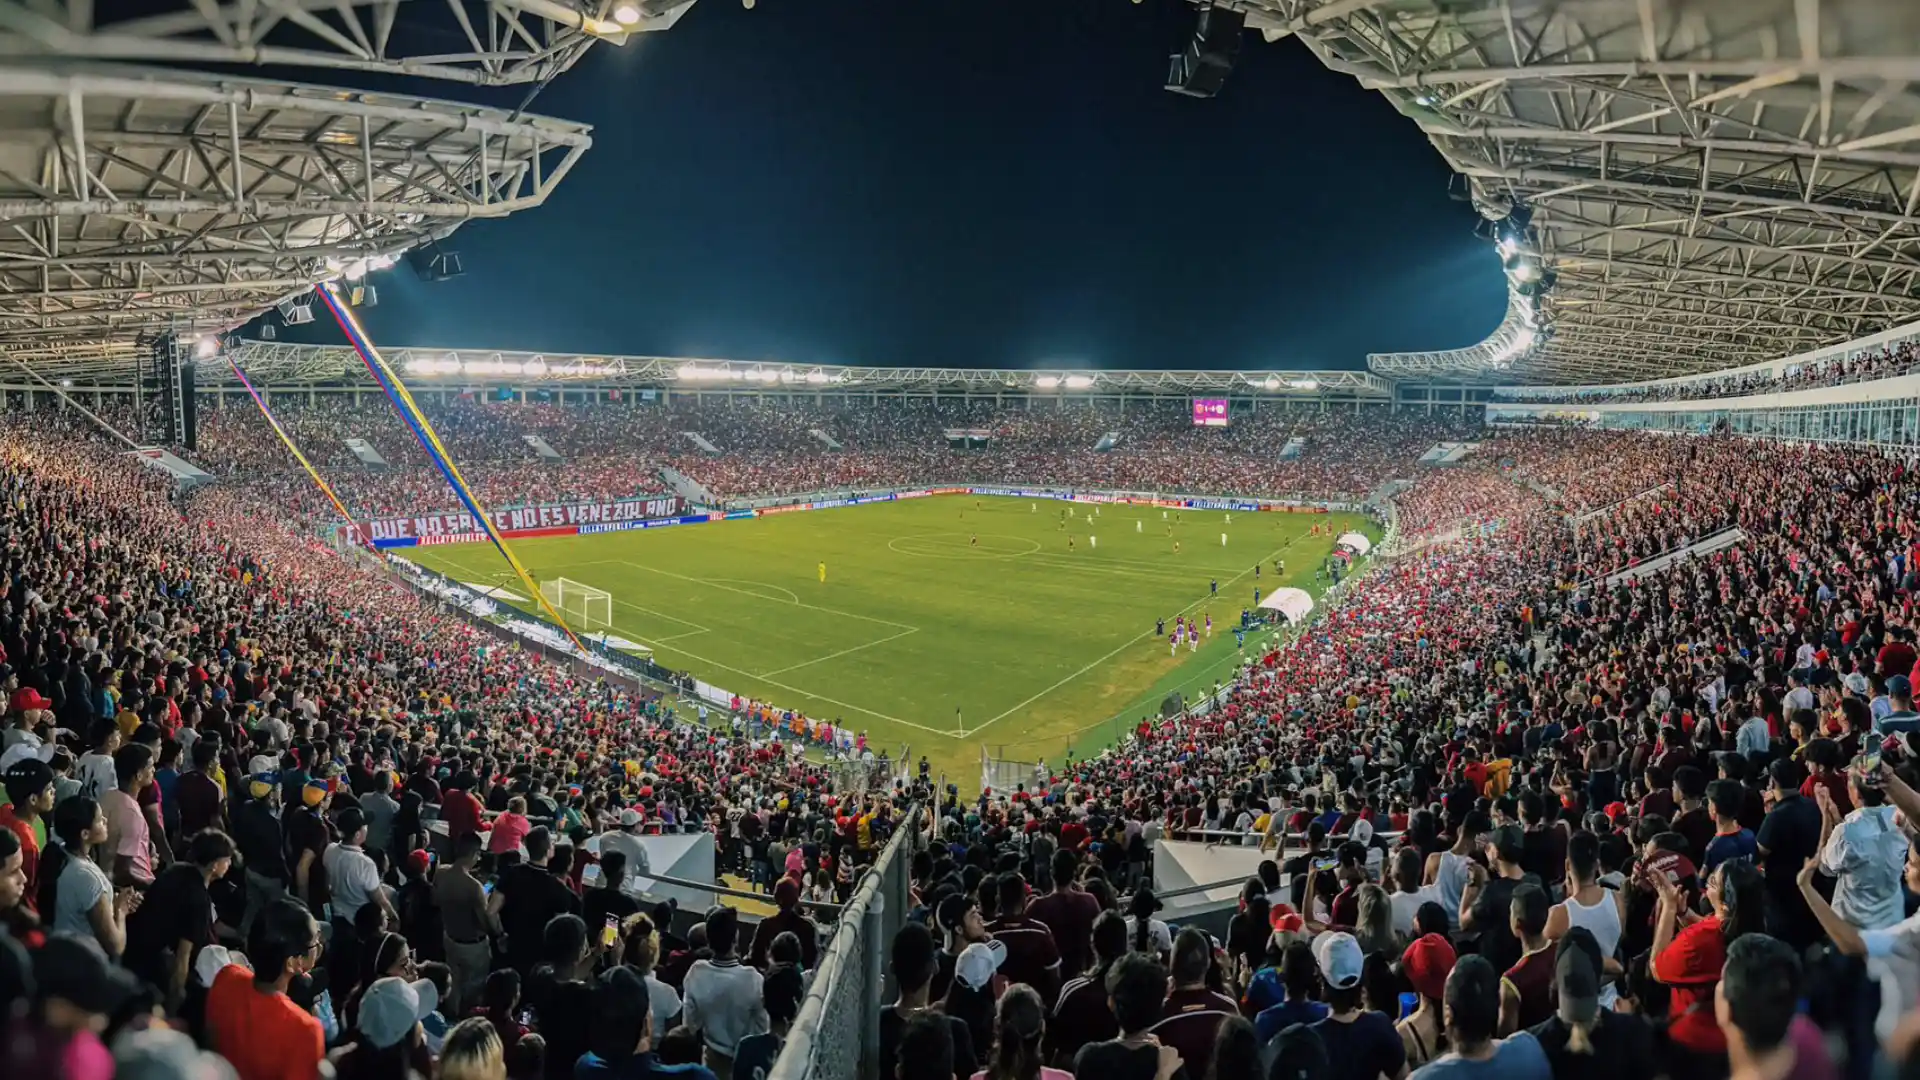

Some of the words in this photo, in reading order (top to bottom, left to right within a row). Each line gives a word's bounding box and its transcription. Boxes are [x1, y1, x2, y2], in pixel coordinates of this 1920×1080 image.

[370, 518, 411, 540] QUE
[414, 517, 445, 536] NO
[445, 510, 509, 534] SALE
[511, 508, 537, 529] NO
[539, 507, 565, 527] ES
